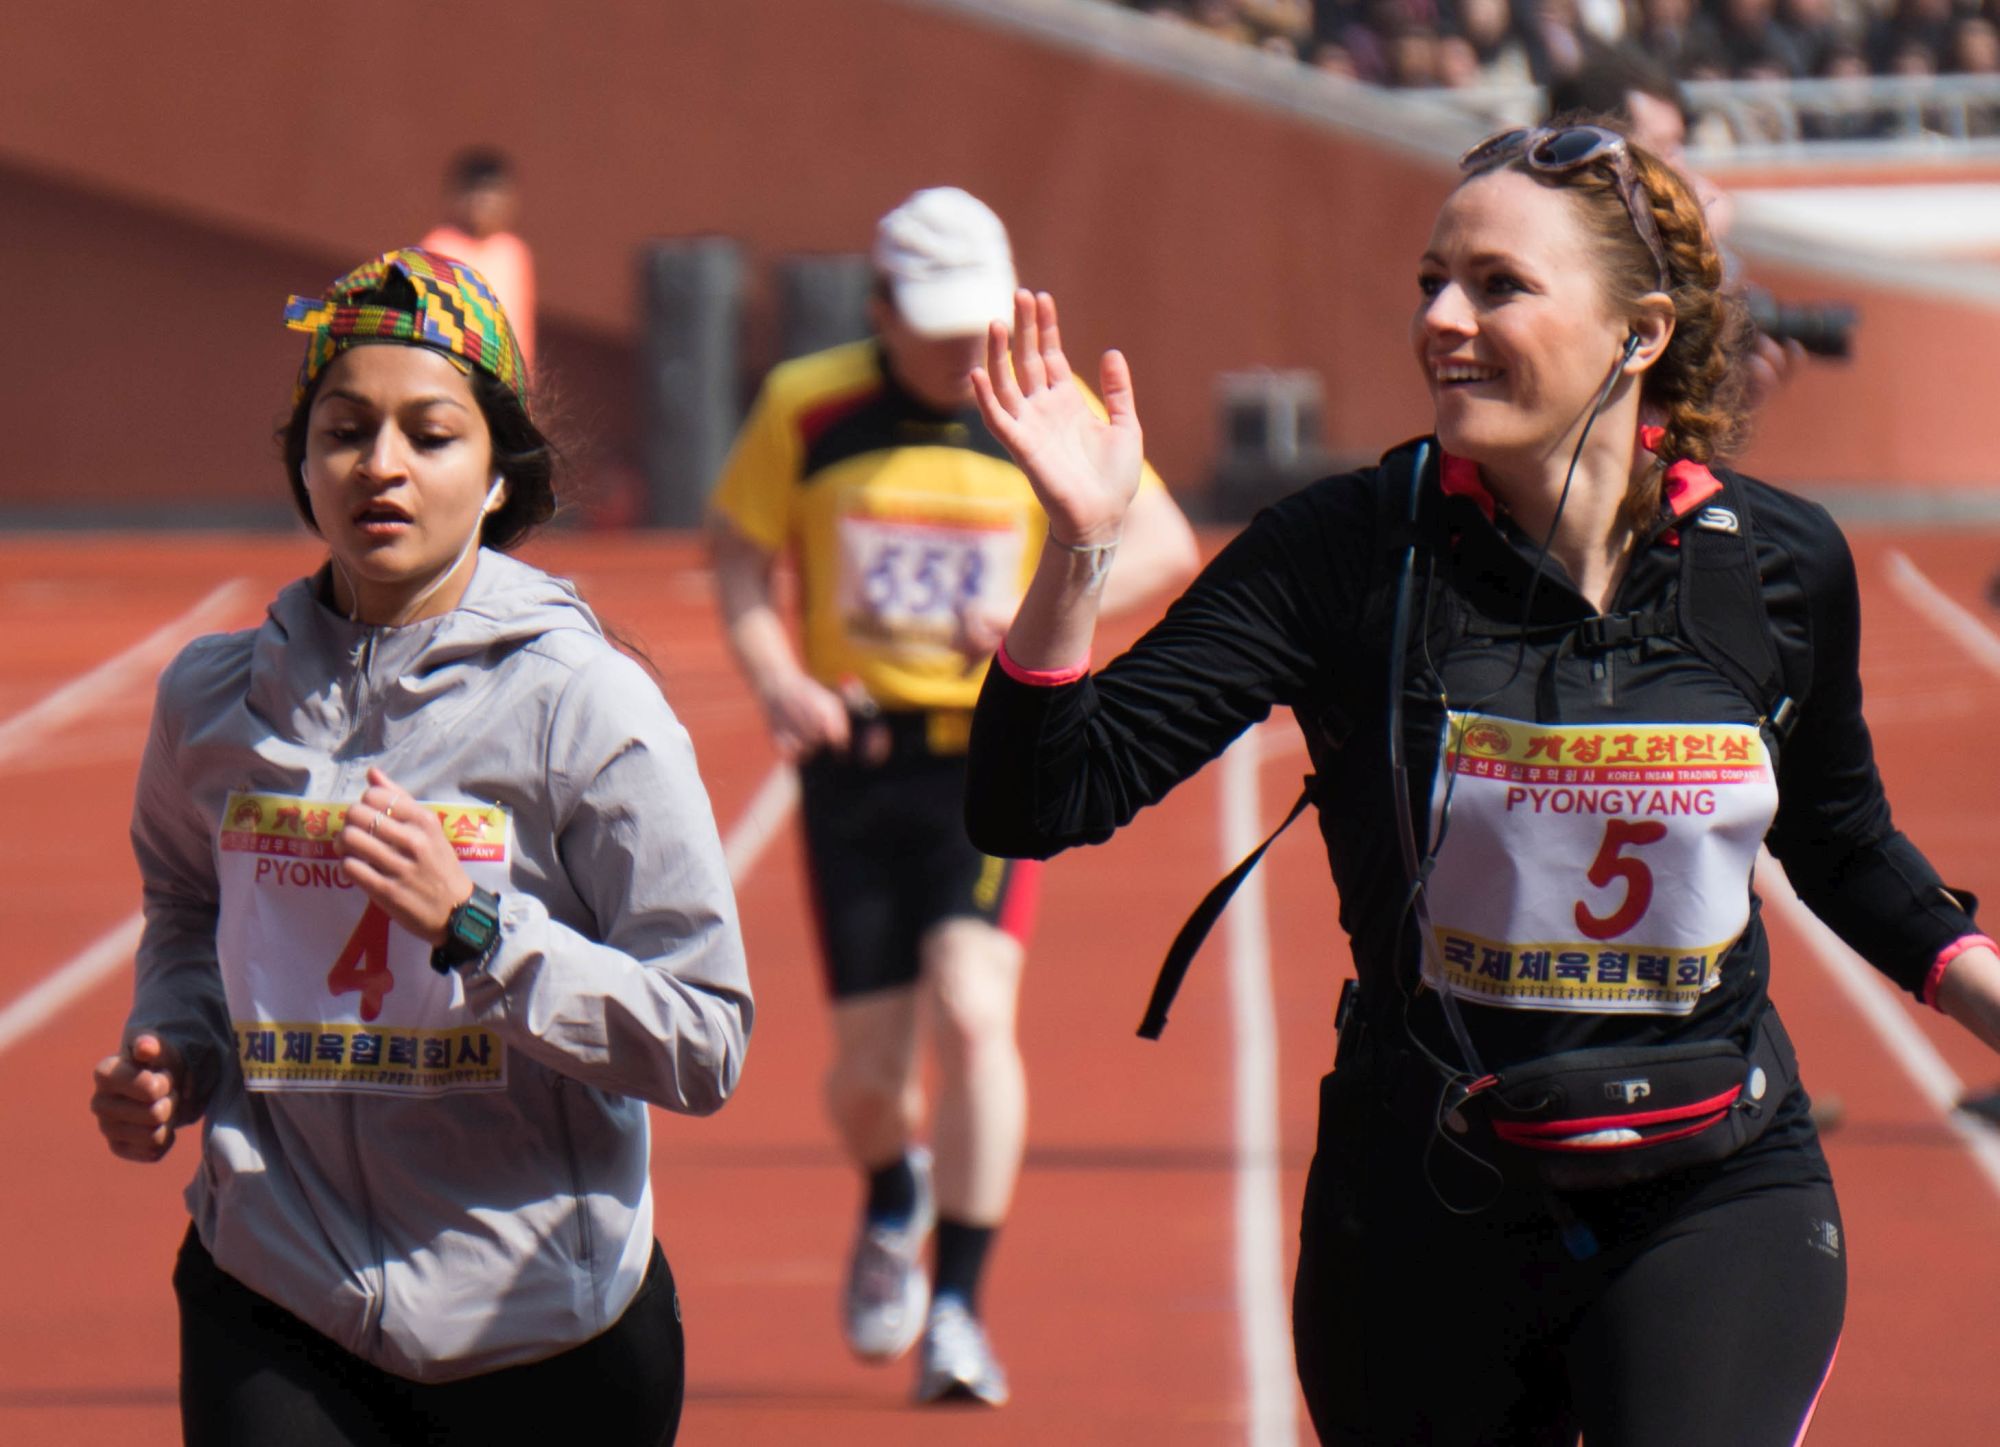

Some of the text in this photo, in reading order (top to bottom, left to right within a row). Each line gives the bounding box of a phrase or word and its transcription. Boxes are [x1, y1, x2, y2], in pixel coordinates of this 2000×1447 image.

[1524, 733, 1755, 763] 개성고려인삼
[1607, 770, 1761, 781] KOREA INSAM TRADING COMPANY
[1506, 785, 1715, 816] PYONGYANG
[455, 846, 496, 857] OMPANY
[1573, 818, 1668, 940] 5
[328, 899, 394, 1022] 4
[233, 1031, 491, 1069] 제체육협력회사
